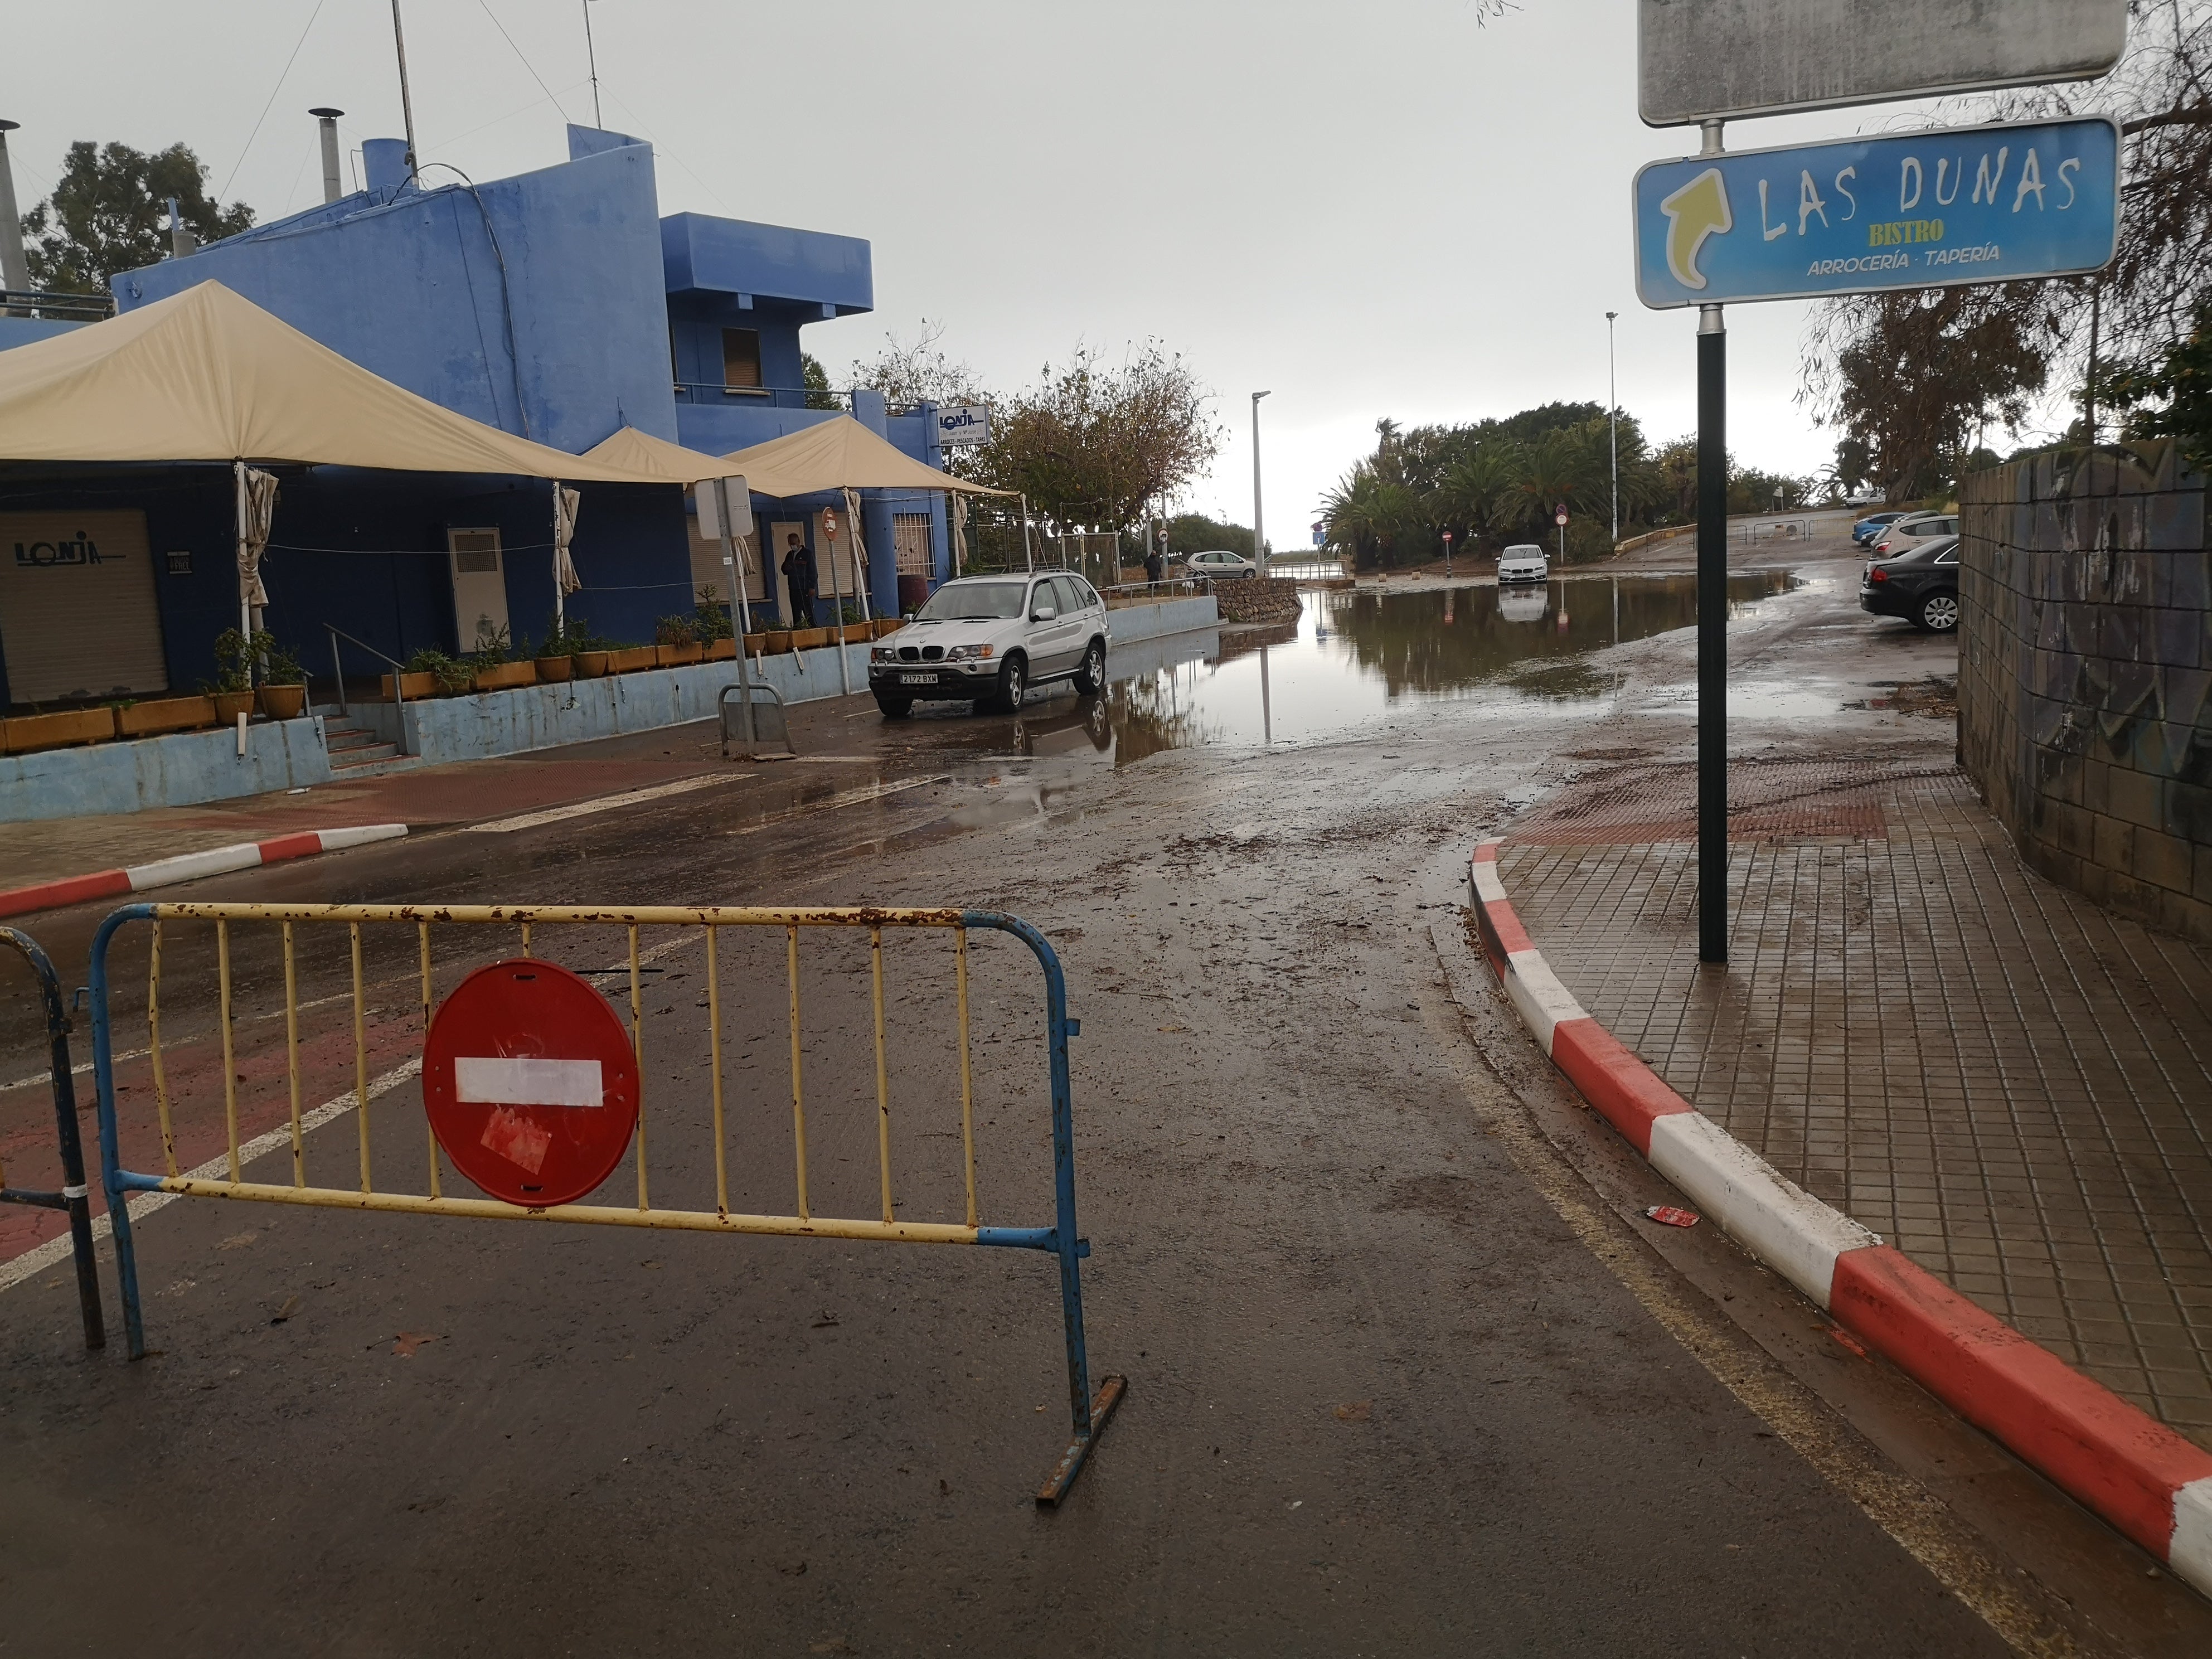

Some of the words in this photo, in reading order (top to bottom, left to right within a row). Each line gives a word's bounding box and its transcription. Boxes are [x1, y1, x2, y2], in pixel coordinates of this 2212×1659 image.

[1758, 166, 1856, 241] LAS
[1900, 146, 2080, 213] DUNAS
[1869, 219, 1944, 246] BISTRO
[1807, 249, 1909, 276] ARROCERÍA
[1924, 241, 2000, 266] TAPERÍA
